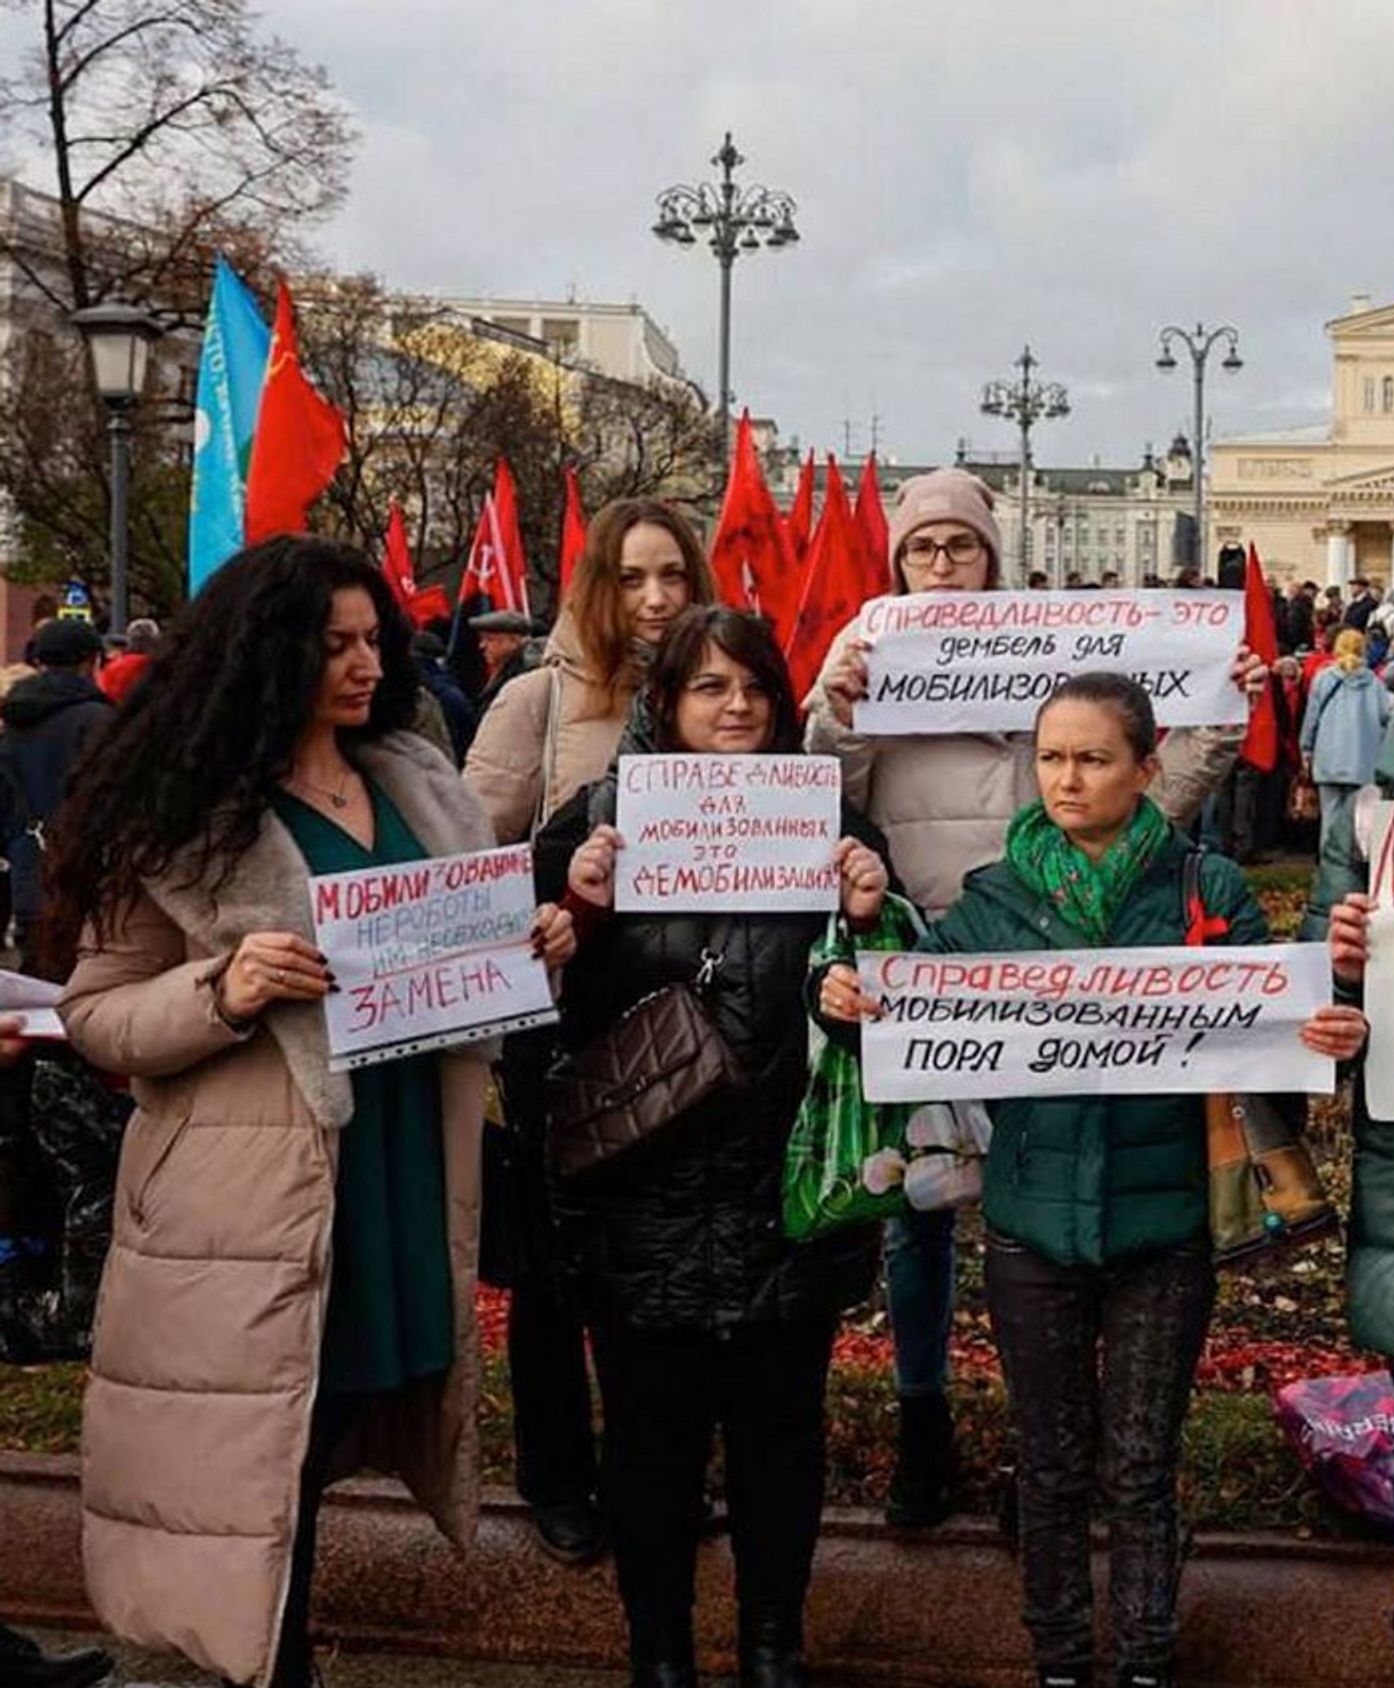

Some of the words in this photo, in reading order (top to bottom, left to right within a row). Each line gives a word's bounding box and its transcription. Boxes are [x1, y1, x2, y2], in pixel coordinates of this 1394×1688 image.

[693, 844, 738, 861] ЭТО
[347, 957, 512, 1033] ЗАМЕНА
[904, 1039, 1005, 1072] ПОРА
